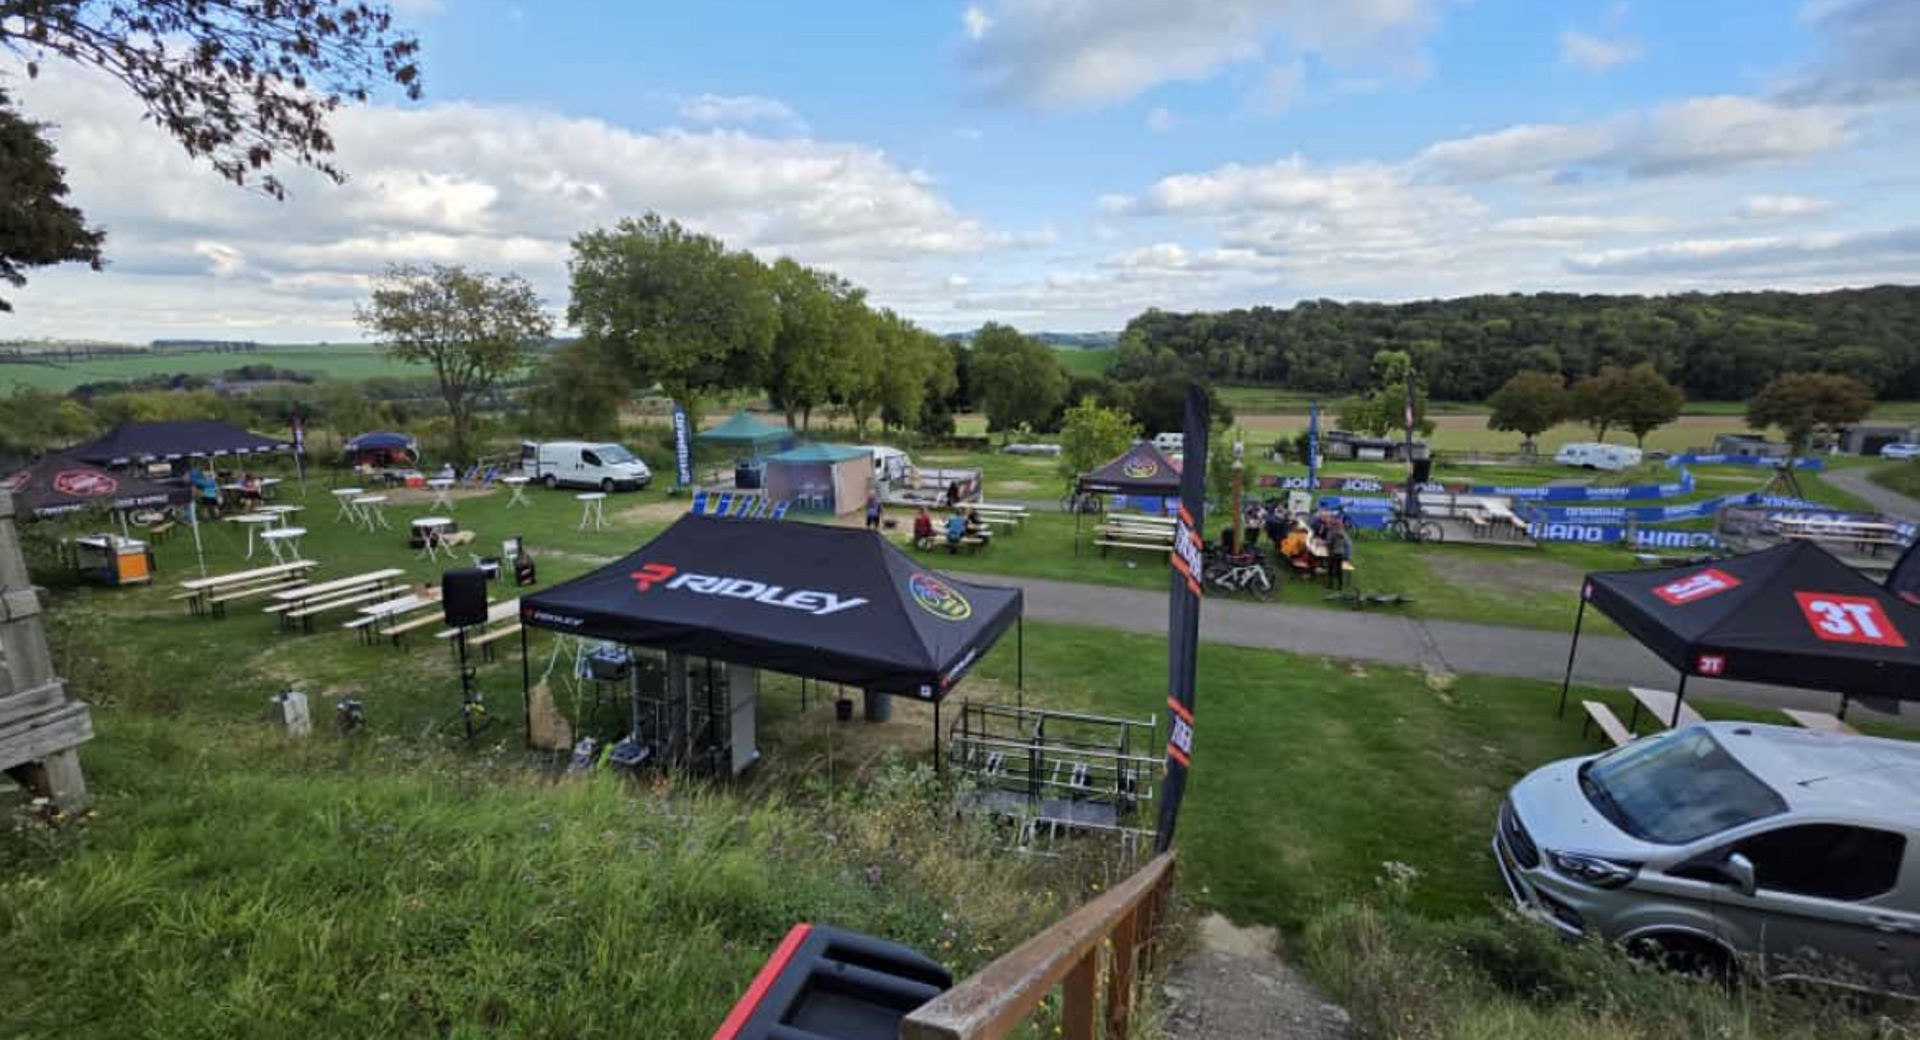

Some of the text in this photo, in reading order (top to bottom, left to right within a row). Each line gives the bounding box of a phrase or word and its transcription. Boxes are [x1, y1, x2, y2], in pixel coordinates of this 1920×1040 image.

[667, 573, 868, 614] RIDLEY
[1809, 600, 1882, 639] 3T
[1699, 656, 1722, 672] 3T
